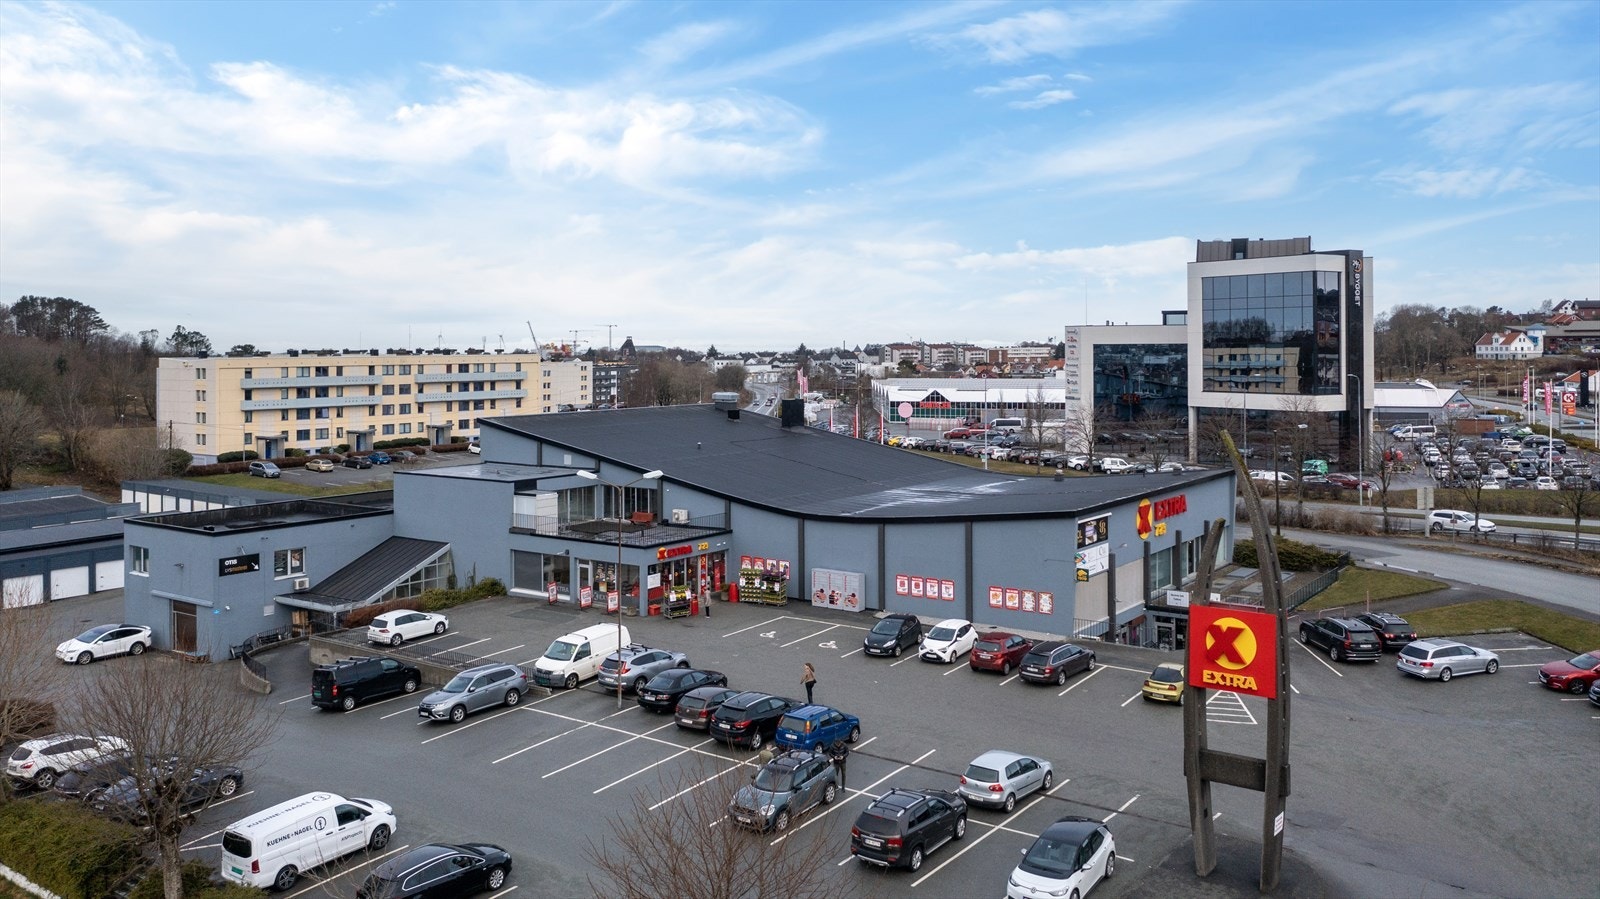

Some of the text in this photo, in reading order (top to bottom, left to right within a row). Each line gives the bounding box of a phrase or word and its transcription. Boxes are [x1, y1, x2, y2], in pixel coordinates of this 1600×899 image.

[1154, 494, 1187, 521] EXTRA
[1203, 670, 1258, 690] EXTRA
[266, 825, 314, 847] KUEHNE+NAGEL
